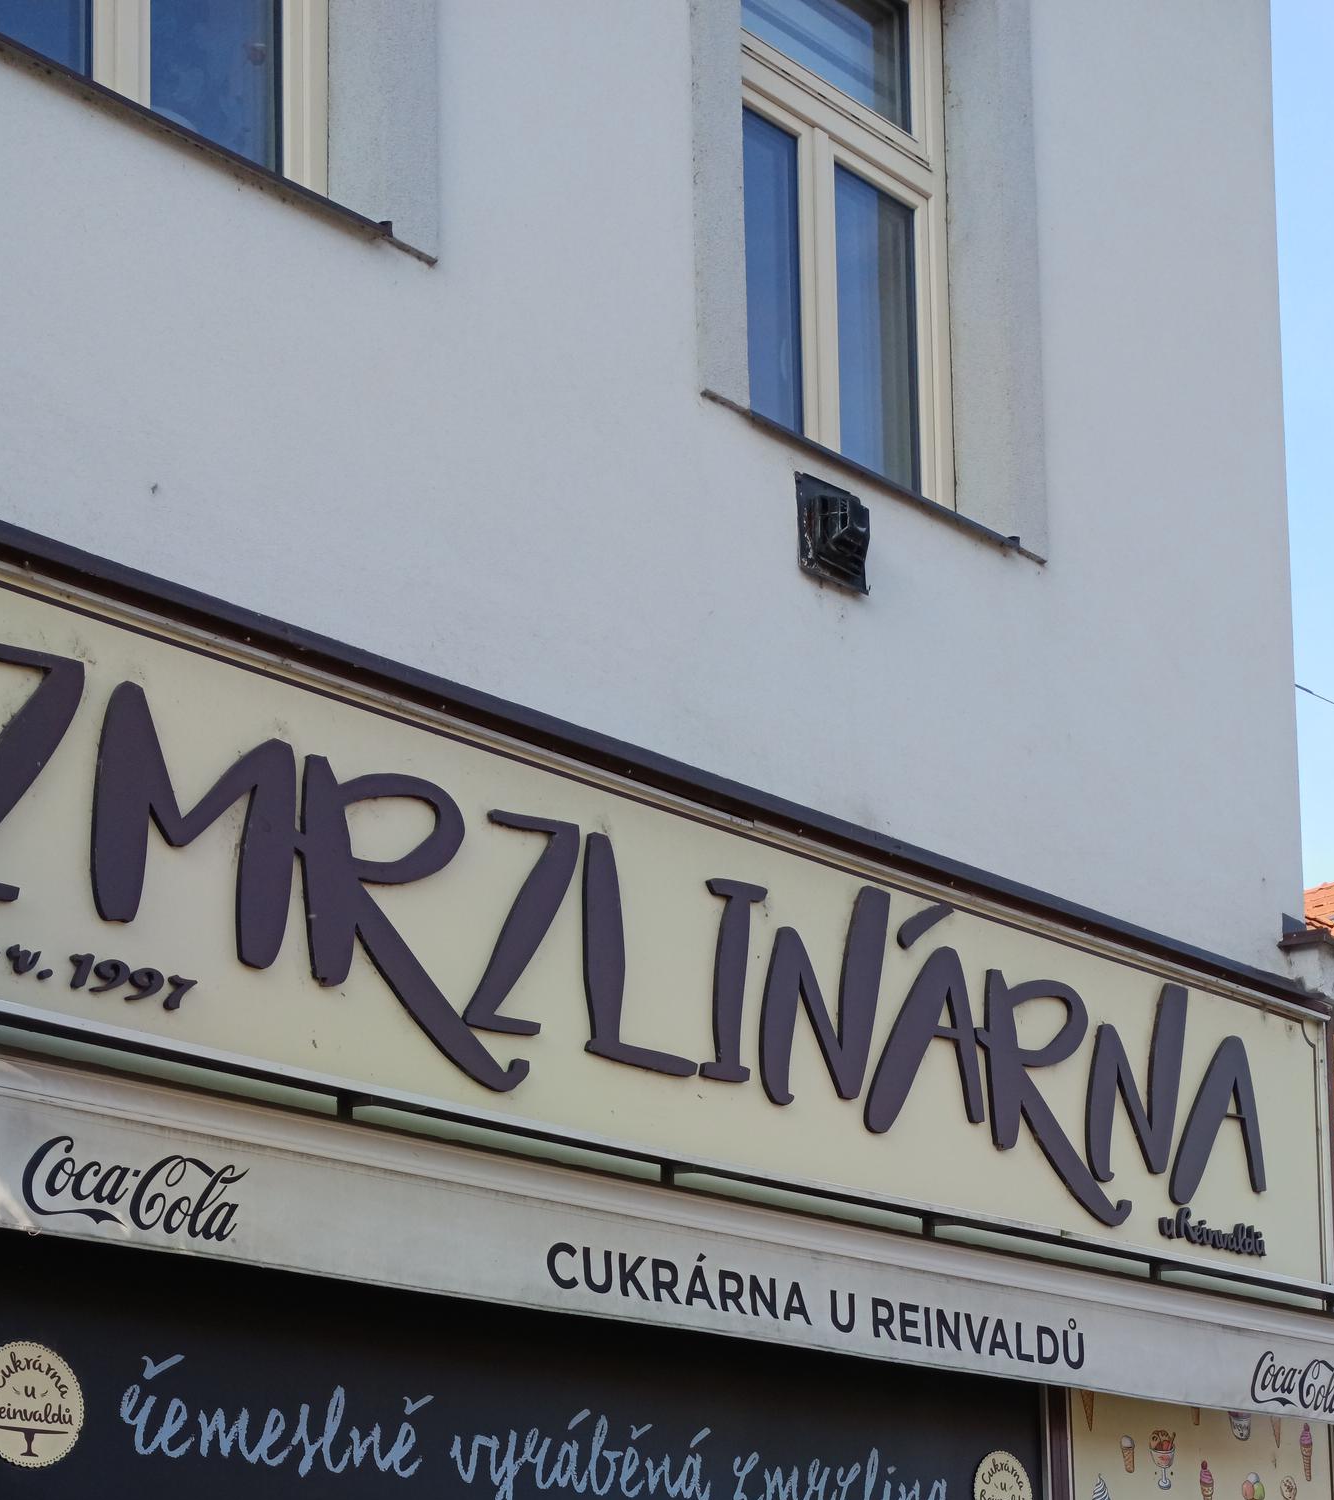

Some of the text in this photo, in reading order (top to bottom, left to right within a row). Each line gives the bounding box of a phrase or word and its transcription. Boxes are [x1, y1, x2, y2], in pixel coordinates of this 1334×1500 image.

[9, 943, 53, 981] v.
[70, 953, 197, 1011] 1997
[22, 1135, 249, 1243] Coca-Cola
[1158, 1216, 1175, 1240] u
[546, 1241, 1086, 1371] CUKRÁRNA U REINVALDŮ
[24, 1385, 37, 1400] u
[981, 1458, 1024, 1491] Cukrárna
[1000, 1482, 1008, 1492] u
